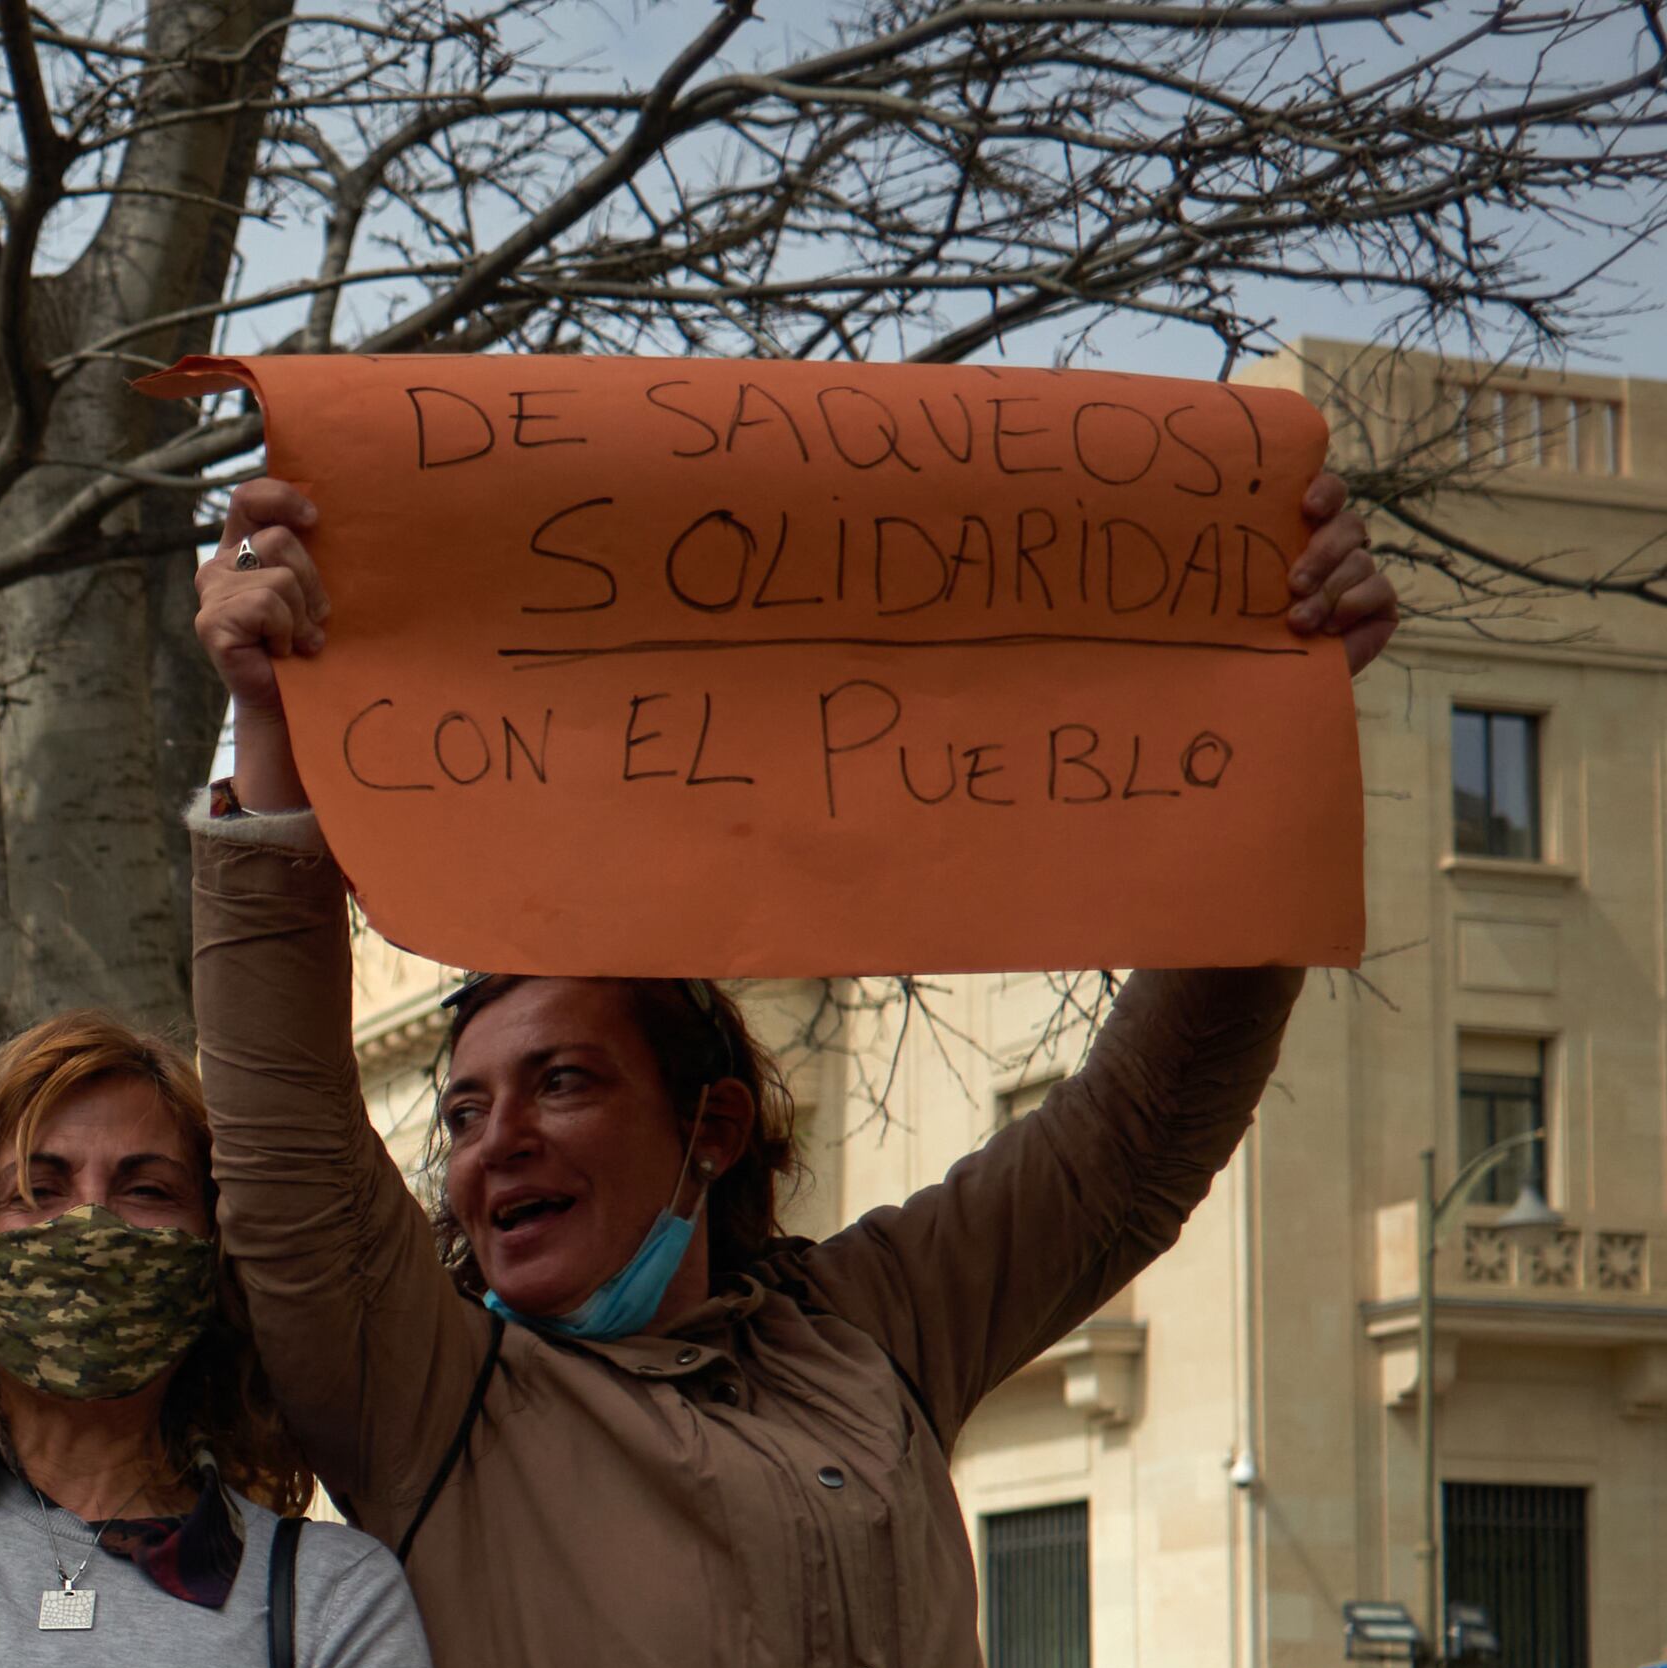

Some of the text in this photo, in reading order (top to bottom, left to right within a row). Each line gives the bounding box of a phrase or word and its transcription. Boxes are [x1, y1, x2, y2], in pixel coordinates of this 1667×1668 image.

[407, 381, 1266, 496] DE SAQUEOS!
[343, 679, 1235, 818] CON EL PUEBLO
